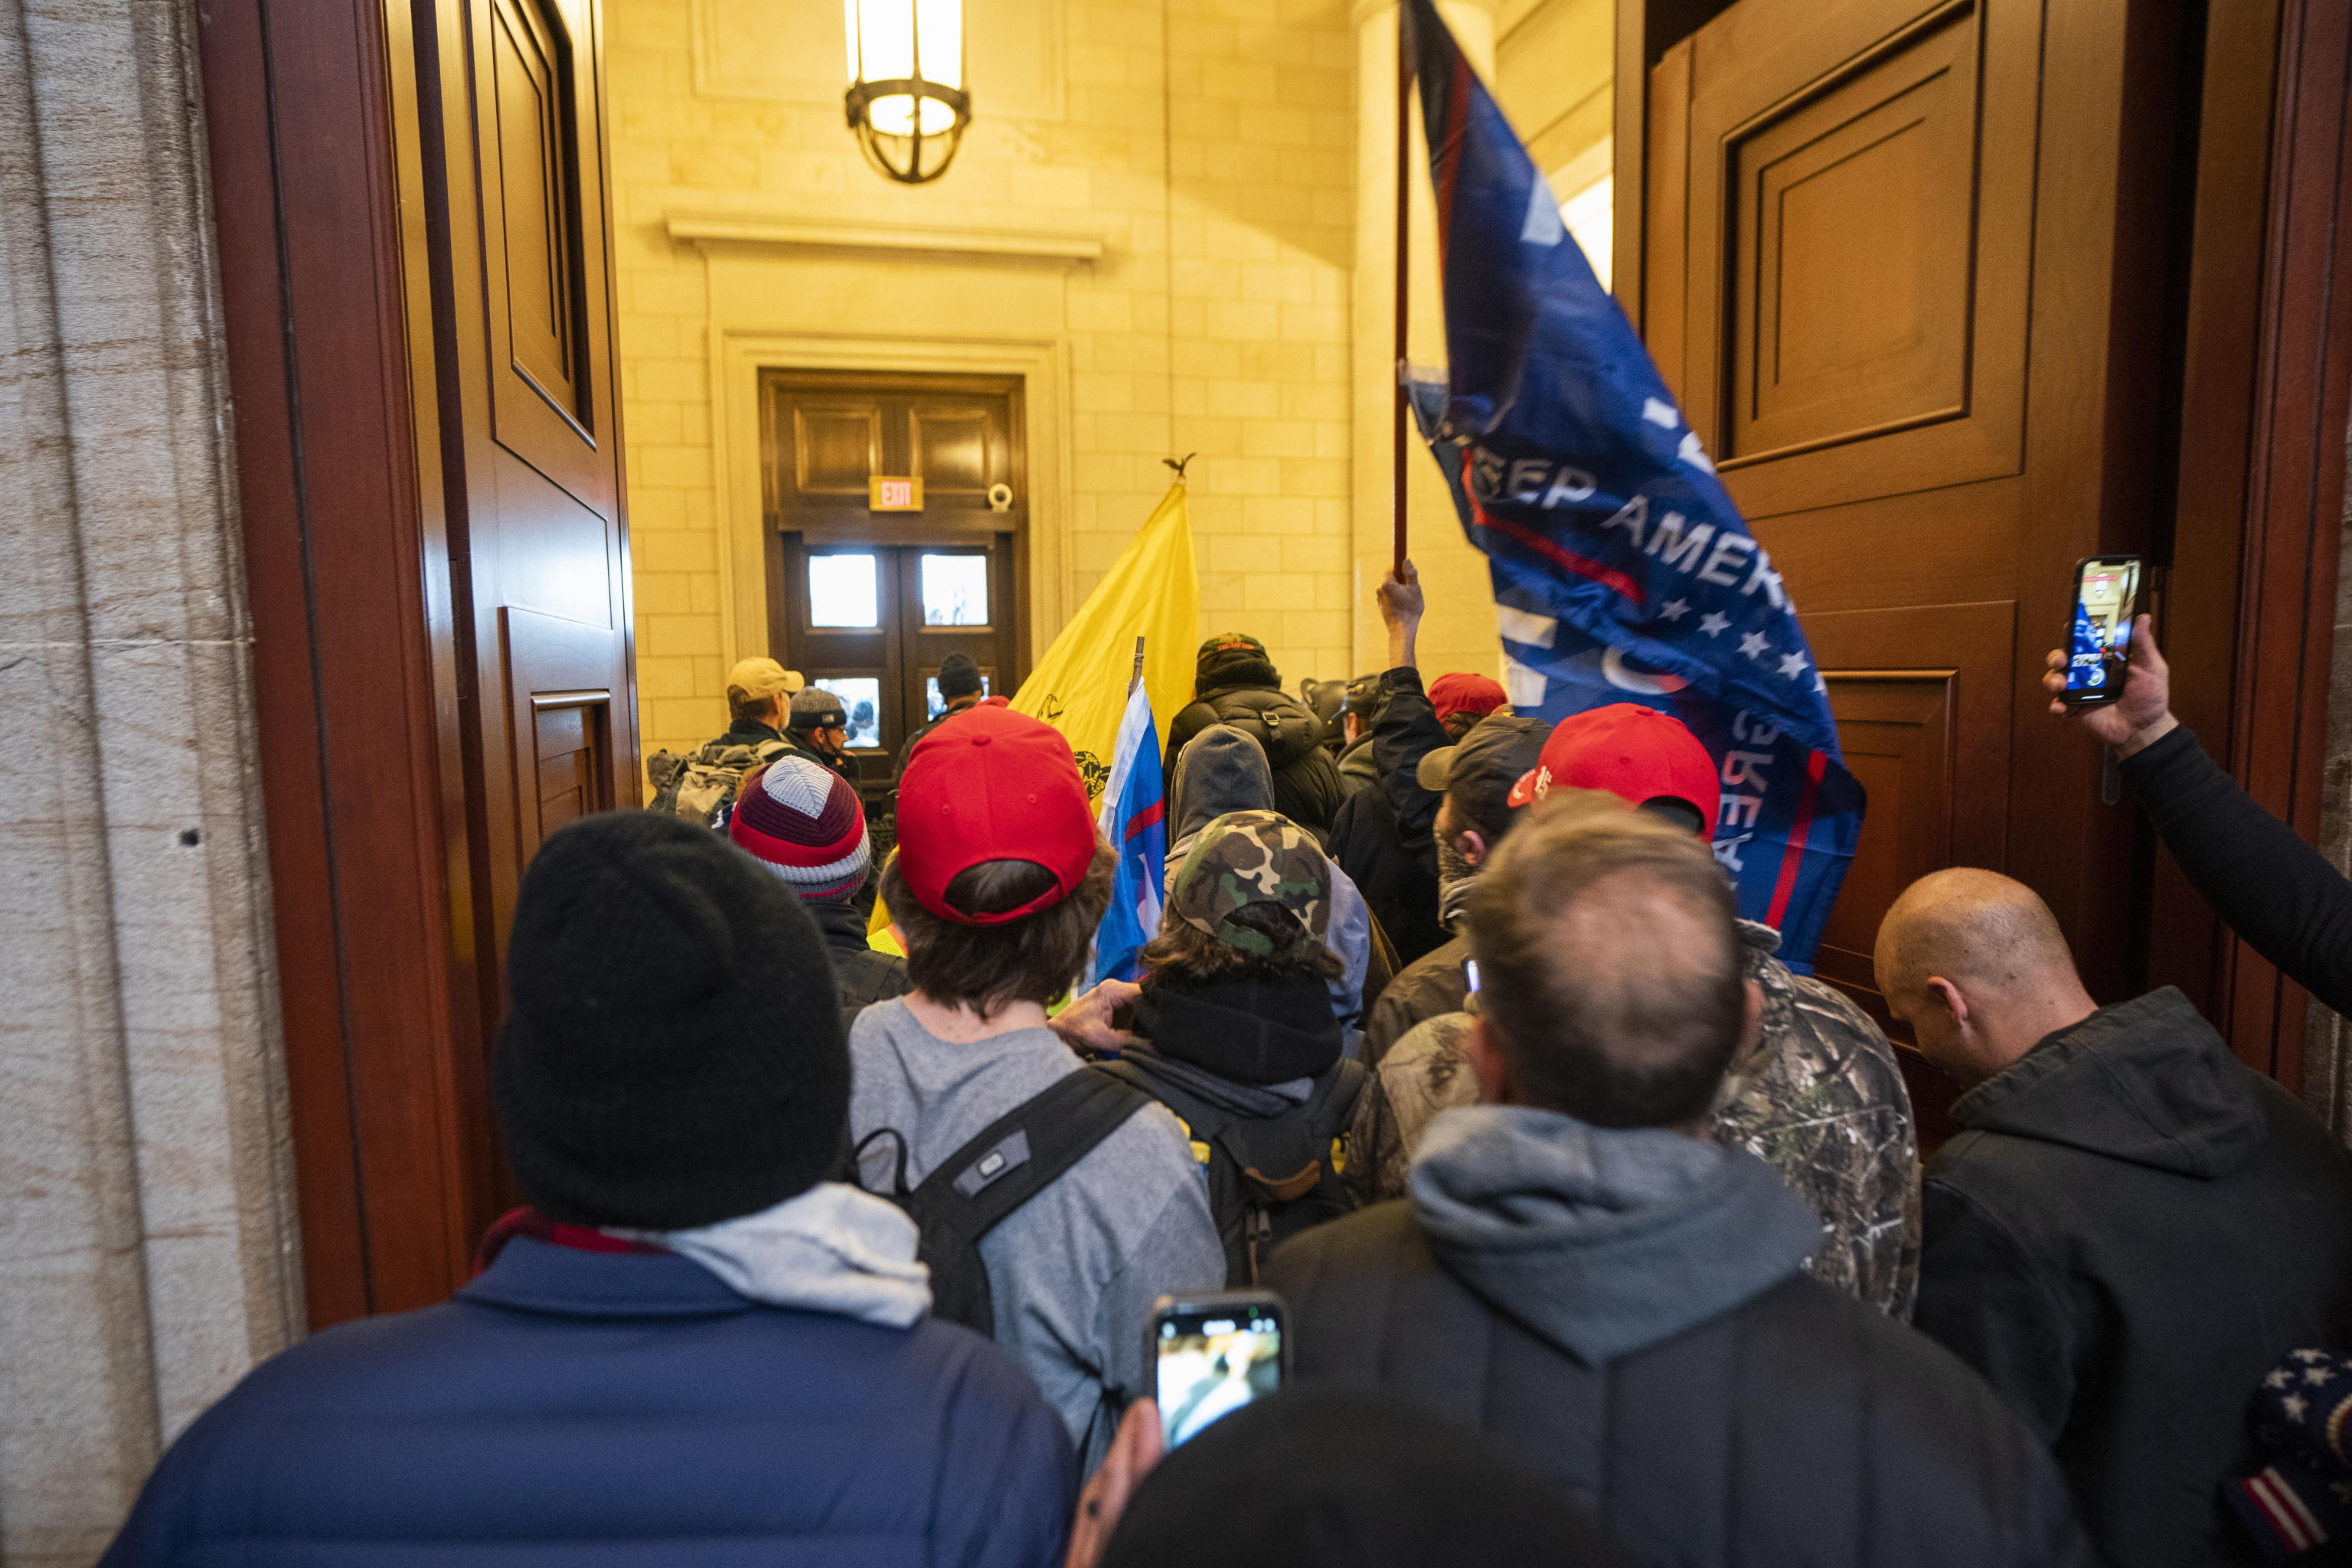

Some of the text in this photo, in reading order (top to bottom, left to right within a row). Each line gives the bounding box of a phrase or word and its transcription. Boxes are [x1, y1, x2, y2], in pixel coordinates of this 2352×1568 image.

[882, 481, 910, 507] EXIT
[1472, 446, 1796, 615] EEP AMER
